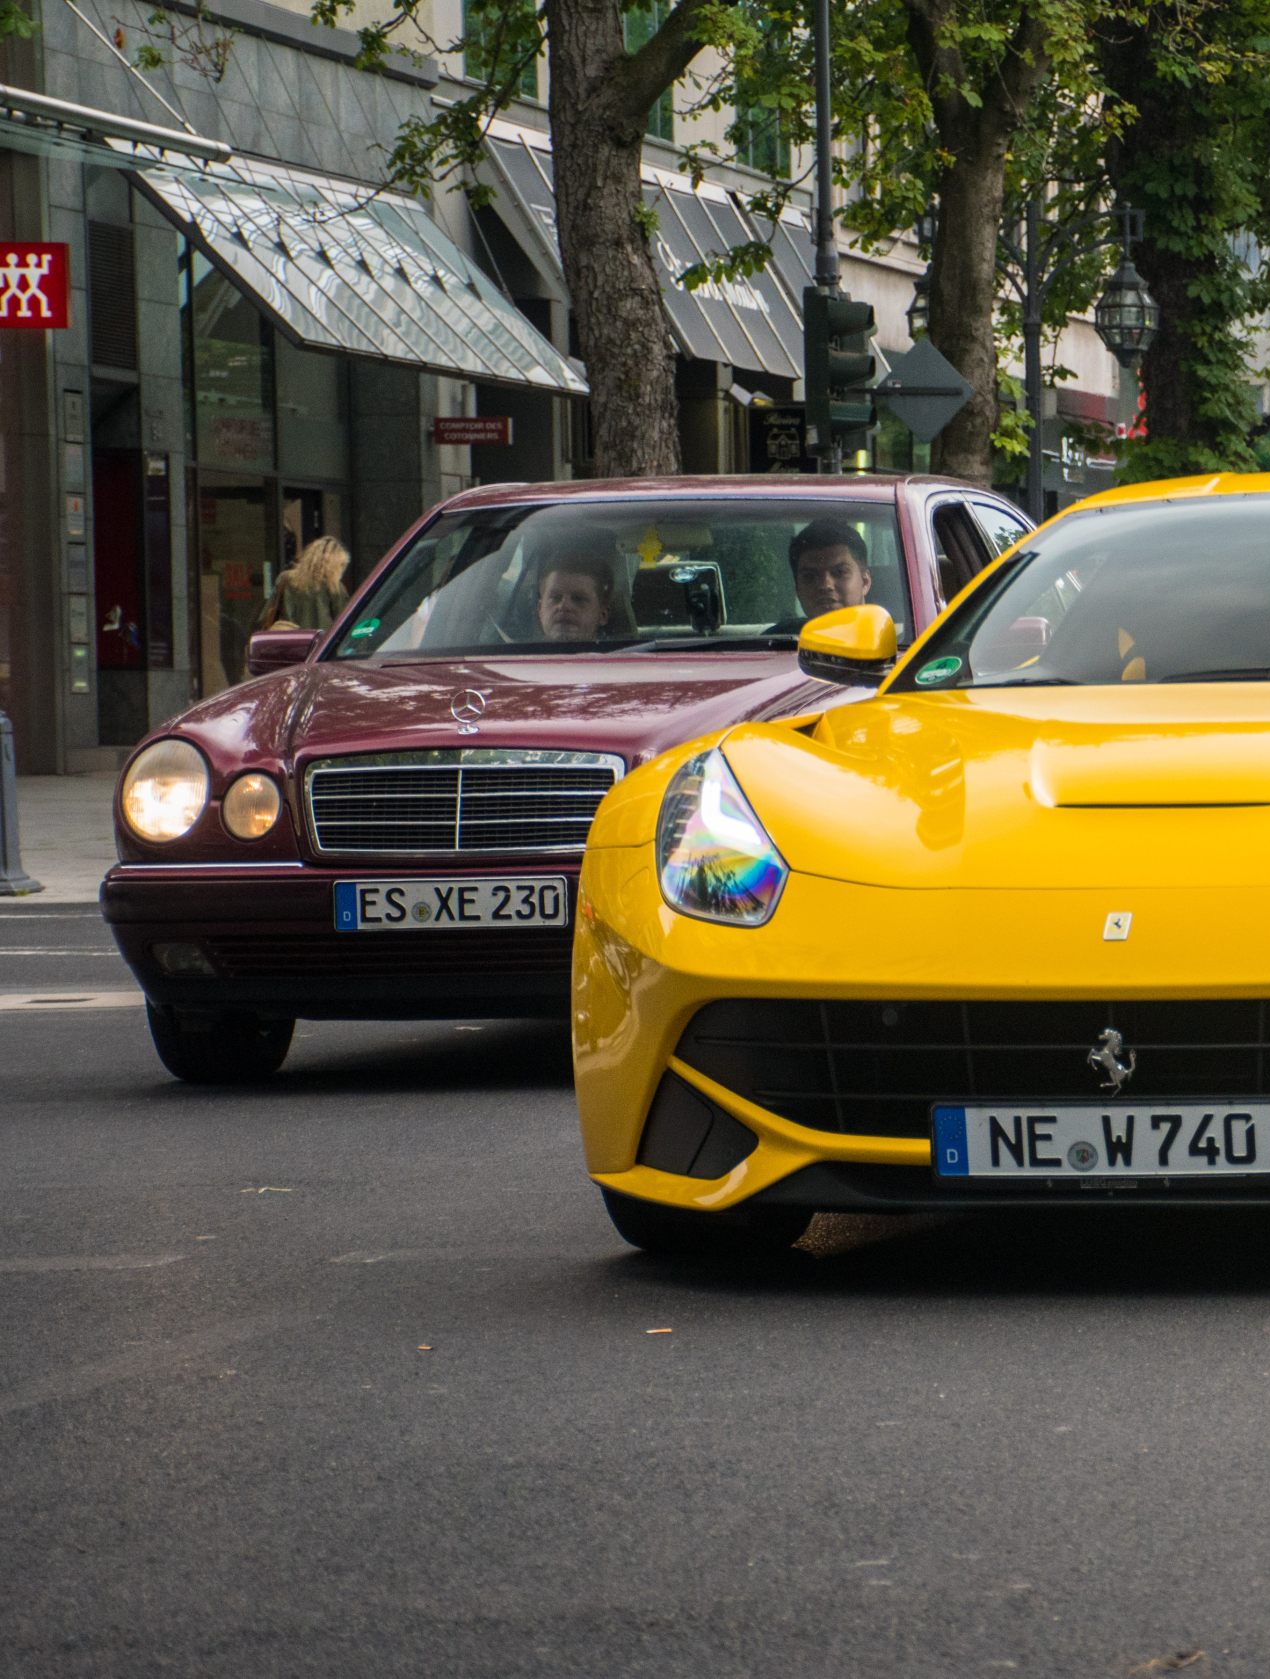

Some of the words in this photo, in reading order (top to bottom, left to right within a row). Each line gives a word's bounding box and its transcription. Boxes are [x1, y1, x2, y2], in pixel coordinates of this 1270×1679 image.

[440, 422, 484, 430] COMPTOIR
[485, 422, 503, 430] DES
[444, 432, 499, 440] COTONNIERS
[359, 888, 407, 924] ES
[434, 886, 481, 922] XE
[491, 885, 560, 921] 230
[947, 1149, 959, 1164] D
[989, 1115, 1062, 1168] NE
[1101, 1114, 1135, 1168] W
[1151, 1113, 1257, 1167] 740
